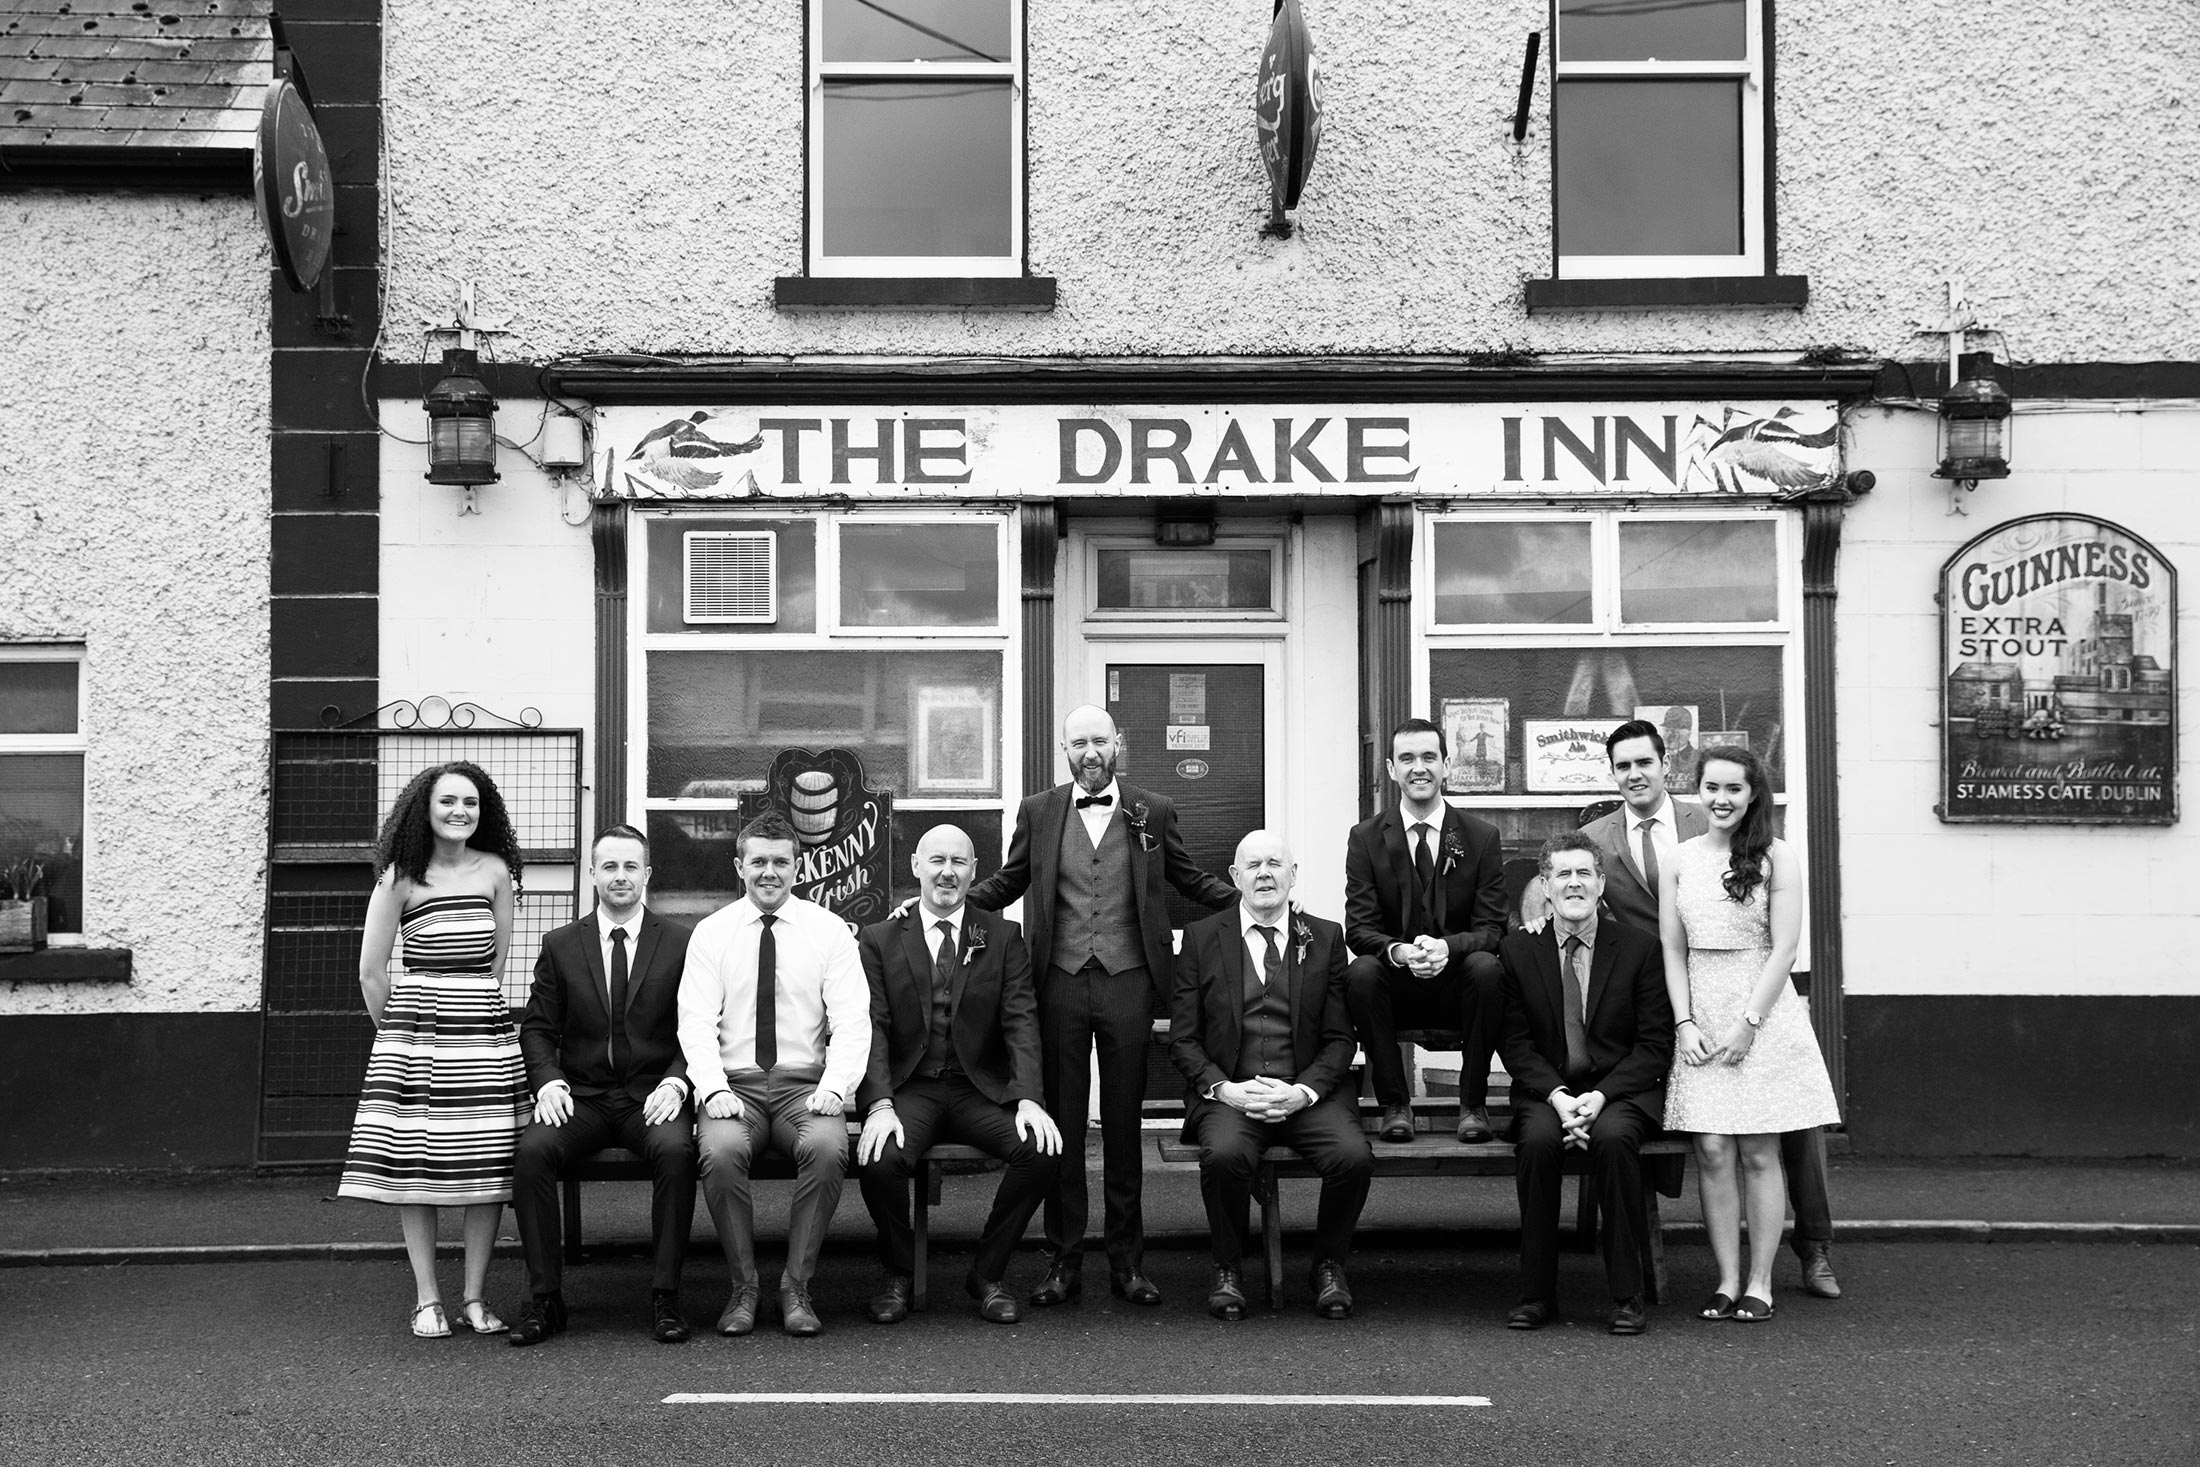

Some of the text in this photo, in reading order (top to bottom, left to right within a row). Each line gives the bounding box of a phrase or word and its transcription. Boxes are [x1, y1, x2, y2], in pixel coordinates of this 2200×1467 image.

[758, 414, 1679, 486] THE DRAKE INN
[1962, 542, 2150, 611] GUINNESS
[1960, 616, 2068, 636] EXTRA
[1959, 638, 2069, 658] STOUT
[2101, 784, 2162, 801] DUBLIN
[808, 864, 872, 910] Irish
